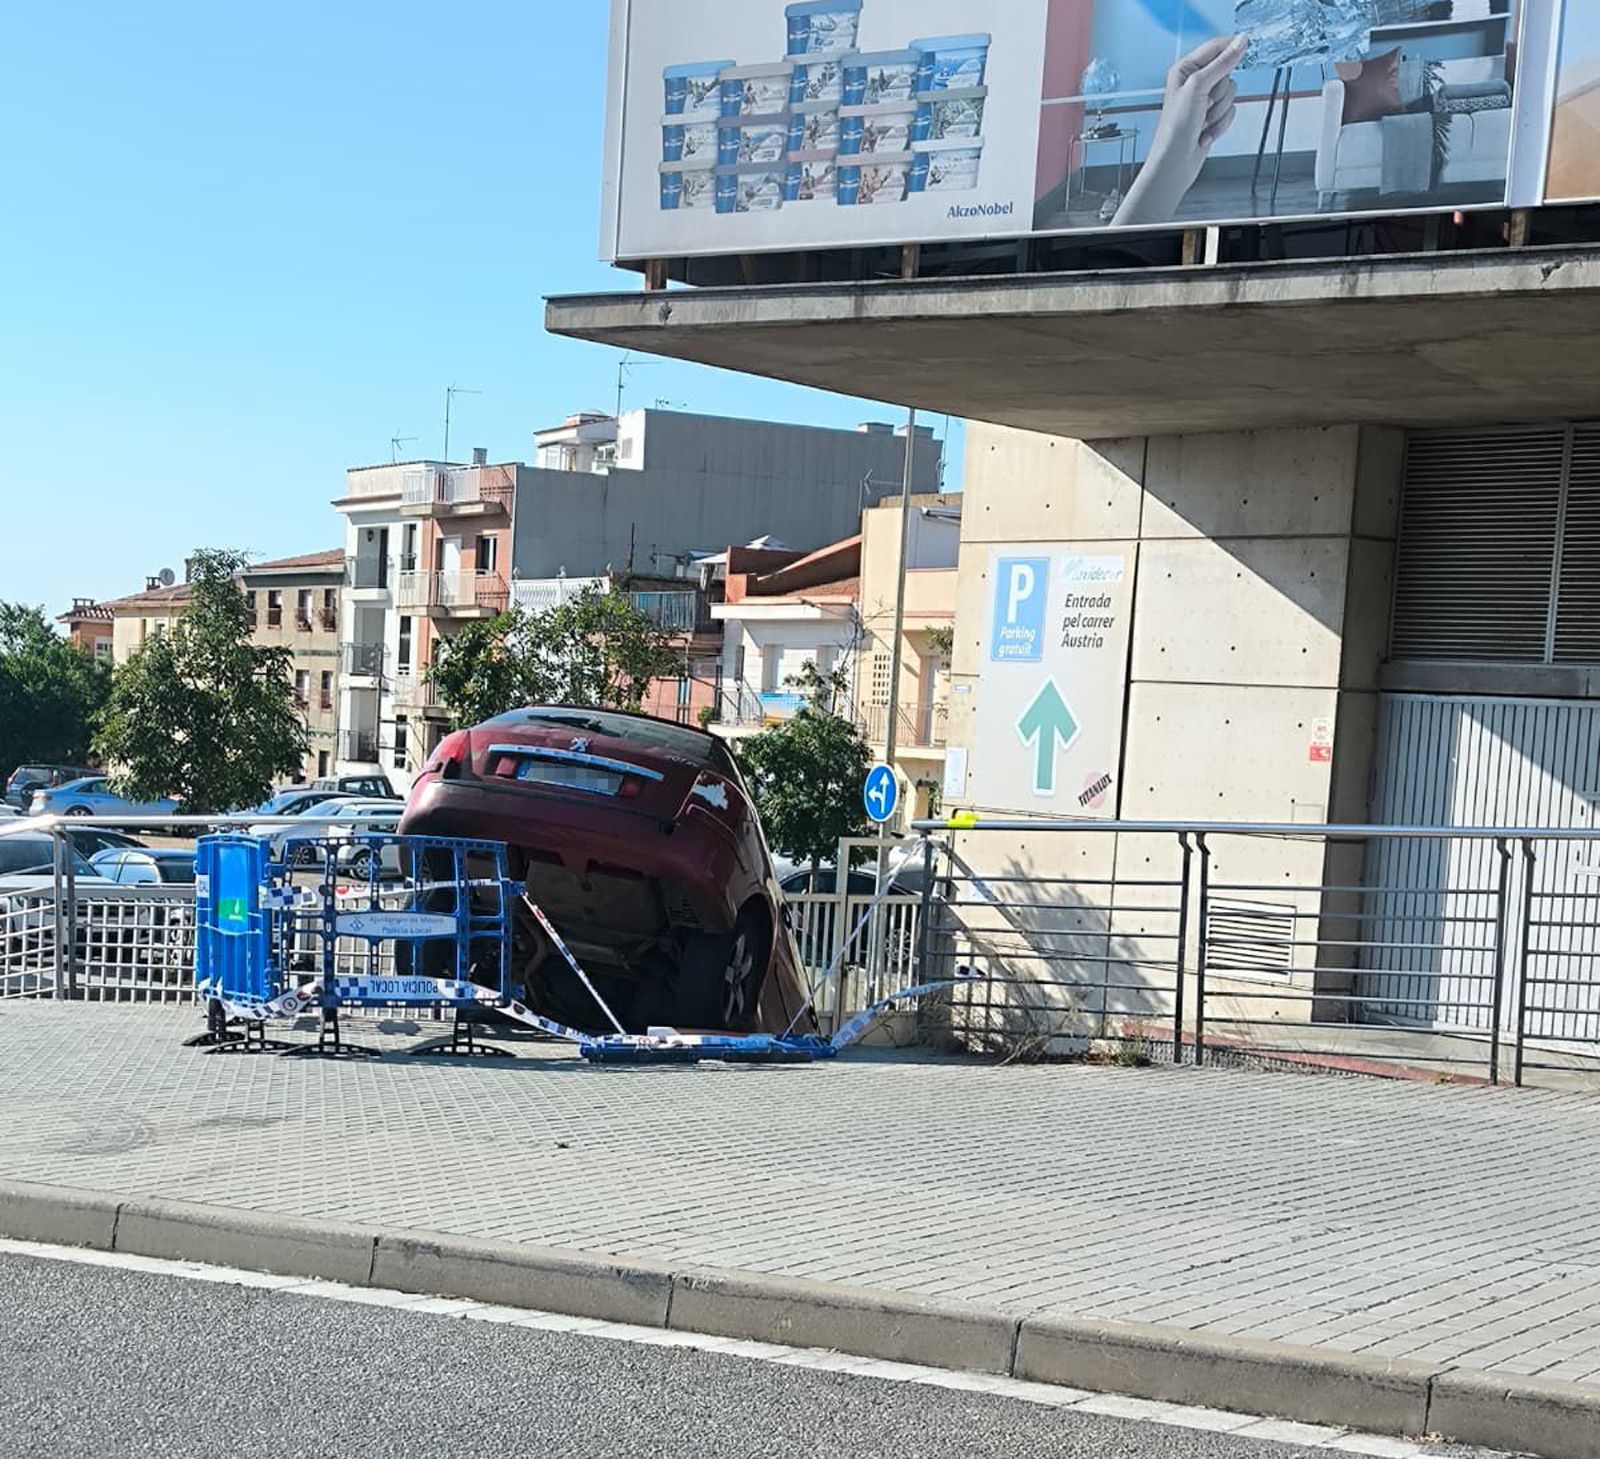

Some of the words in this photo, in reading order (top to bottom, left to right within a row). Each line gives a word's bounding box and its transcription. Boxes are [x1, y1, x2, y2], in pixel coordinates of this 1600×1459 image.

[947, 201, 1013, 217] AkzoNobel
[1007, 563, 1034, 623] P
[1064, 593, 1111, 608] Entrada
[1062, 613, 1081, 631] pel
[1082, 617, 1114, 628] carrer
[1000, 627, 1035, 641] Parking
[1078, 772, 1112, 807] TITANLUX
[371, 980, 399, 994] LOCAL
